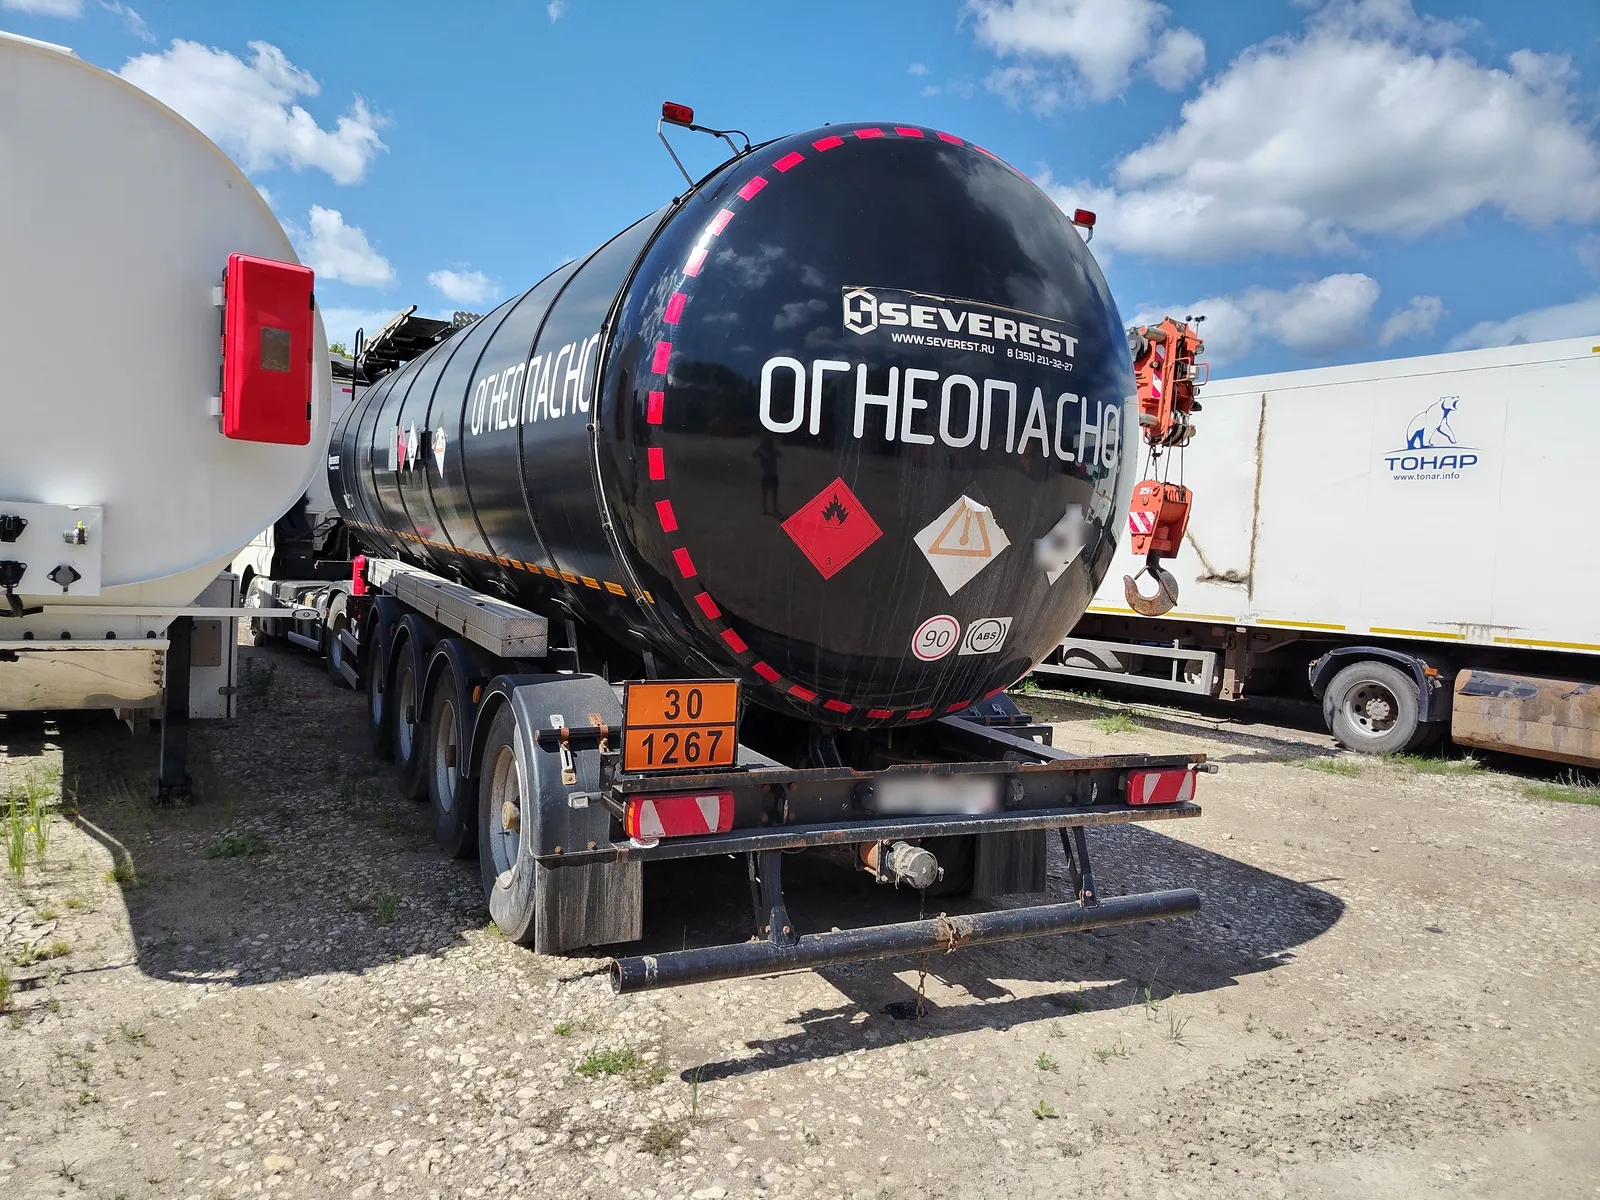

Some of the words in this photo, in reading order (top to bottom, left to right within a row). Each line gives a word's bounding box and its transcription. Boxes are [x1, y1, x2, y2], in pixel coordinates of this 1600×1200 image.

[879, 301, 1079, 358] SEVEREST
[891, 332, 995, 355] WWW.SEVEREST.RU
[1007, 348, 1014, 358] 8
[1015, 348, 1036, 364] (351)
[1036, 354, 1073, 372] 211-32-27
[759, 356, 1120, 469] ОГНЕОПАСНО
[1384, 454, 1478, 471] ТОНАР
[1393, 471, 1460, 481] www.tonar.info
[826, 556, 832, 565] 3
[922, 630, 950, 648] 90
[975, 631, 997, 641] ABS
[664, 688, 703, 721] 30
[641, 730, 723, 765] 1267
